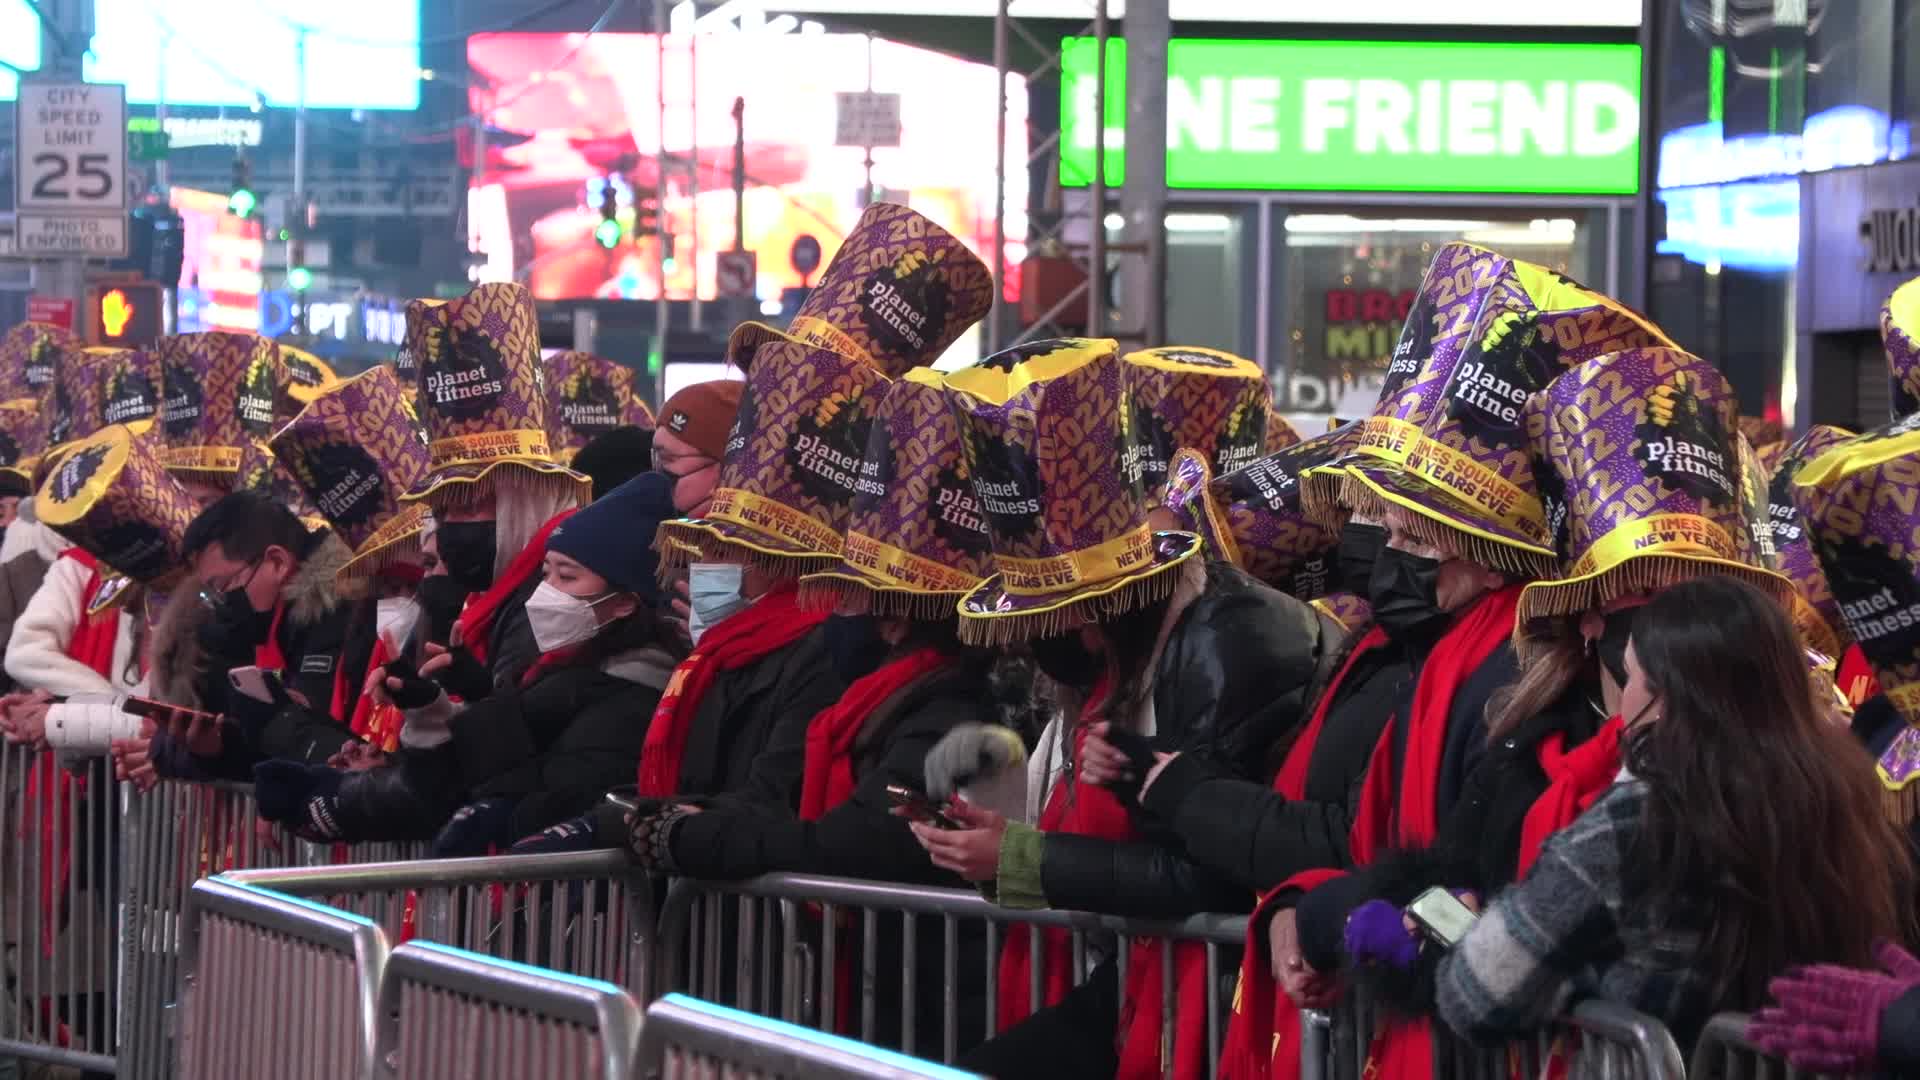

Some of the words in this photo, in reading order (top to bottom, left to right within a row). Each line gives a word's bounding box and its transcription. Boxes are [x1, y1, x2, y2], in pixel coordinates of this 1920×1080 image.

[47, 88, 90, 104] CITY
[38, 109, 102, 126] SPEED
[1074, 75, 1281, 153] LNE
[1304, 79, 1640, 157] FRIEND
[44, 131, 95, 145] LIMIT
[33, 153, 112, 198] 25
[868, 280, 927, 330] planet
[868, 295, 925, 350] fitness
[427, 365, 487, 392] planet
[435, 379, 502, 403] fitness
[243, 406, 272, 422] fitnes
[564, 403, 608, 416] planet
[1455, 379, 1520, 426] fitne
[571, 413, 617, 425] fitness
[456, 447, 496, 460] YEARS
[499, 445, 523, 455] EVE
[470, 433, 519, 449] SQUARE
[794, 434, 861, 473] planet
[1218, 443, 1257, 464] planet
[1377, 435, 1405, 454] EVE
[1646, 436, 1725, 470] planet
[974, 477, 1021, 497] planet
[1246, 463, 1285, 511] fitness
[1261, 458, 1296, 489] planet
[1405, 452, 1422, 470] EW
[1423, 460, 1477, 497] YEARS
[1477, 490, 1512, 518] EVE
[1453, 453, 1521, 507] SQUARE
[1662, 454, 1734, 497] fitness
[319, 469, 361, 513] planet
[330, 473, 379, 518] fitness
[983, 497, 1041, 515] fitness
[711, 502, 731, 514] EVE
[739, 505, 771, 528] NEW
[774, 521, 818, 549] YEARS
[759, 500, 799, 526] TIMES
[799, 518, 842, 549] SQUARE
[941, 504, 990, 534] fitne
[1648, 517, 1702, 532] TIMES
[1633, 531, 1676, 549] NEW
[846, 535, 881, 556] QUARE
[903, 556, 943, 580] TIMES
[1006, 575, 1042, 588] YEARS
[1044, 572, 1075, 586] EVE
[1115, 549, 1143, 568] NEW
[886, 563, 919, 585] NEW
[1842, 585, 1898, 620] lanet
[1850, 602, 1920, 641] itness
